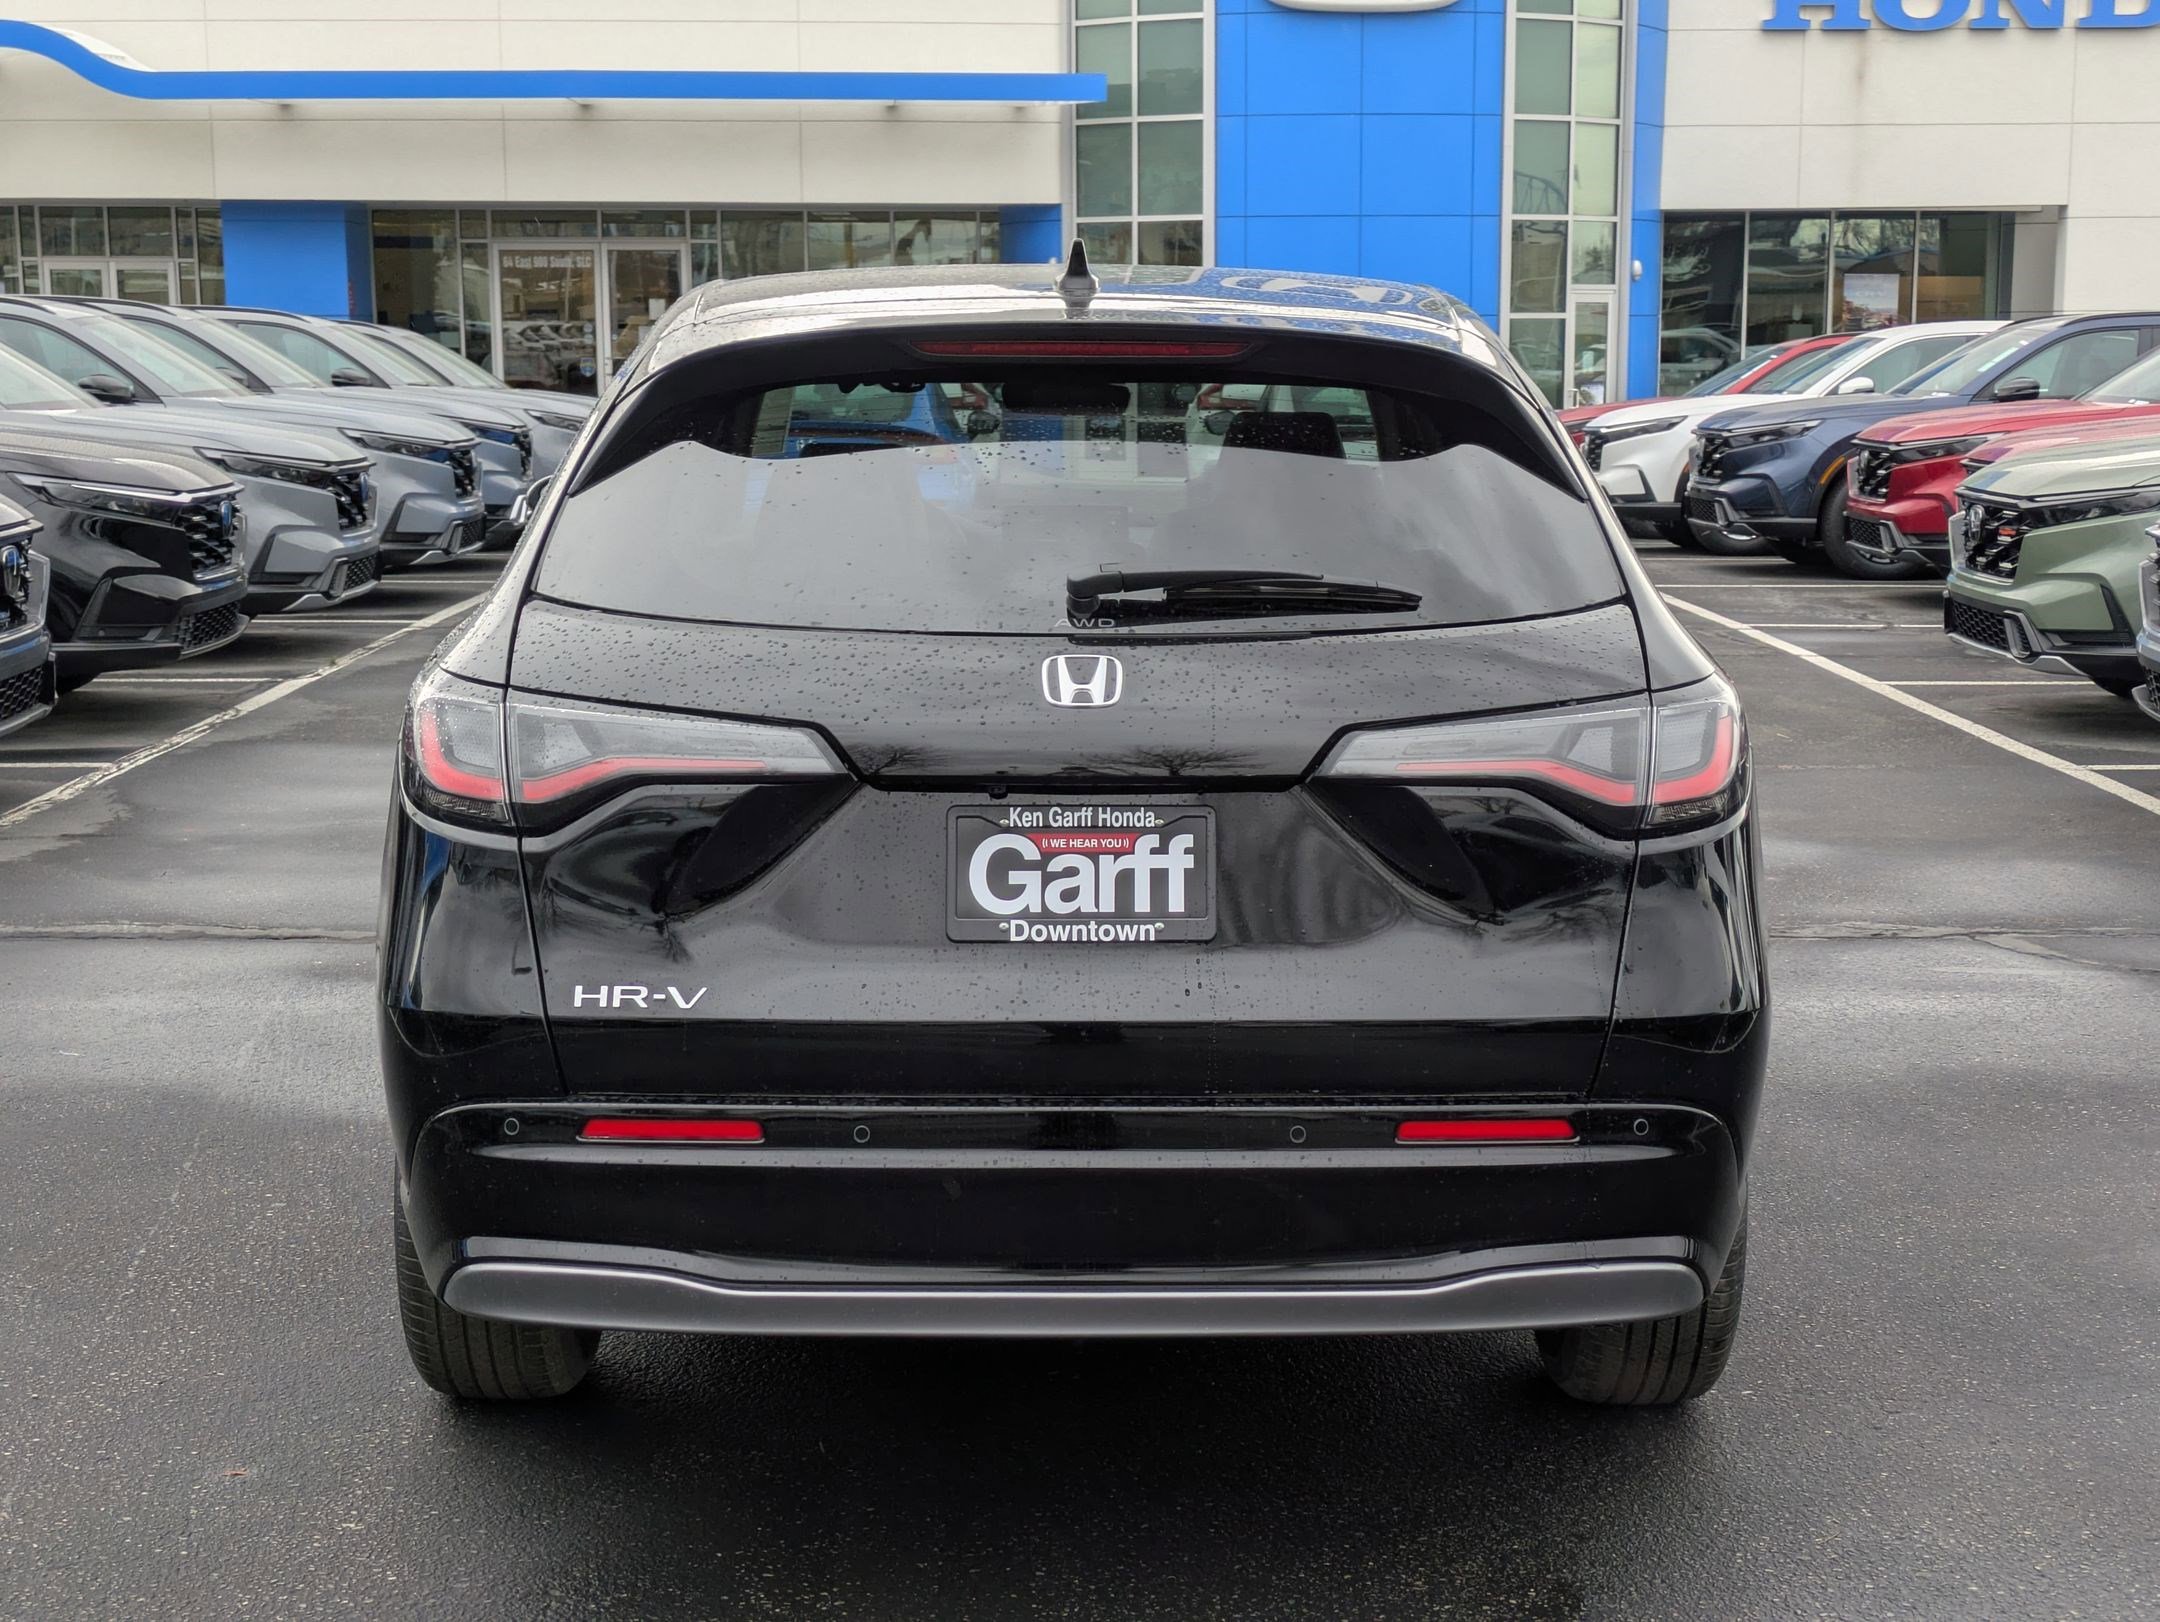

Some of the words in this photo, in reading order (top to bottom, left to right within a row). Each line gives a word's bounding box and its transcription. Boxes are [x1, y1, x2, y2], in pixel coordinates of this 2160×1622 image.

[515, 256, 532, 269] East
[576, 256, 592, 268] SLC
[1054, 618, 1115, 628] AWD
[1009, 807, 1043, 828] Ken
[1048, 807, 1093, 828] Garff
[1098, 807, 1155, 828] Honda
[1050, 838, 1067, 848] WE
[1069, 838, 1098, 848] HEAR
[1100, 838, 1122, 848] YOU
[969, 833, 1195, 915] Garff
[1009, 920, 1155, 942] Downtown
[573, 985, 708, 1009] HR-V
